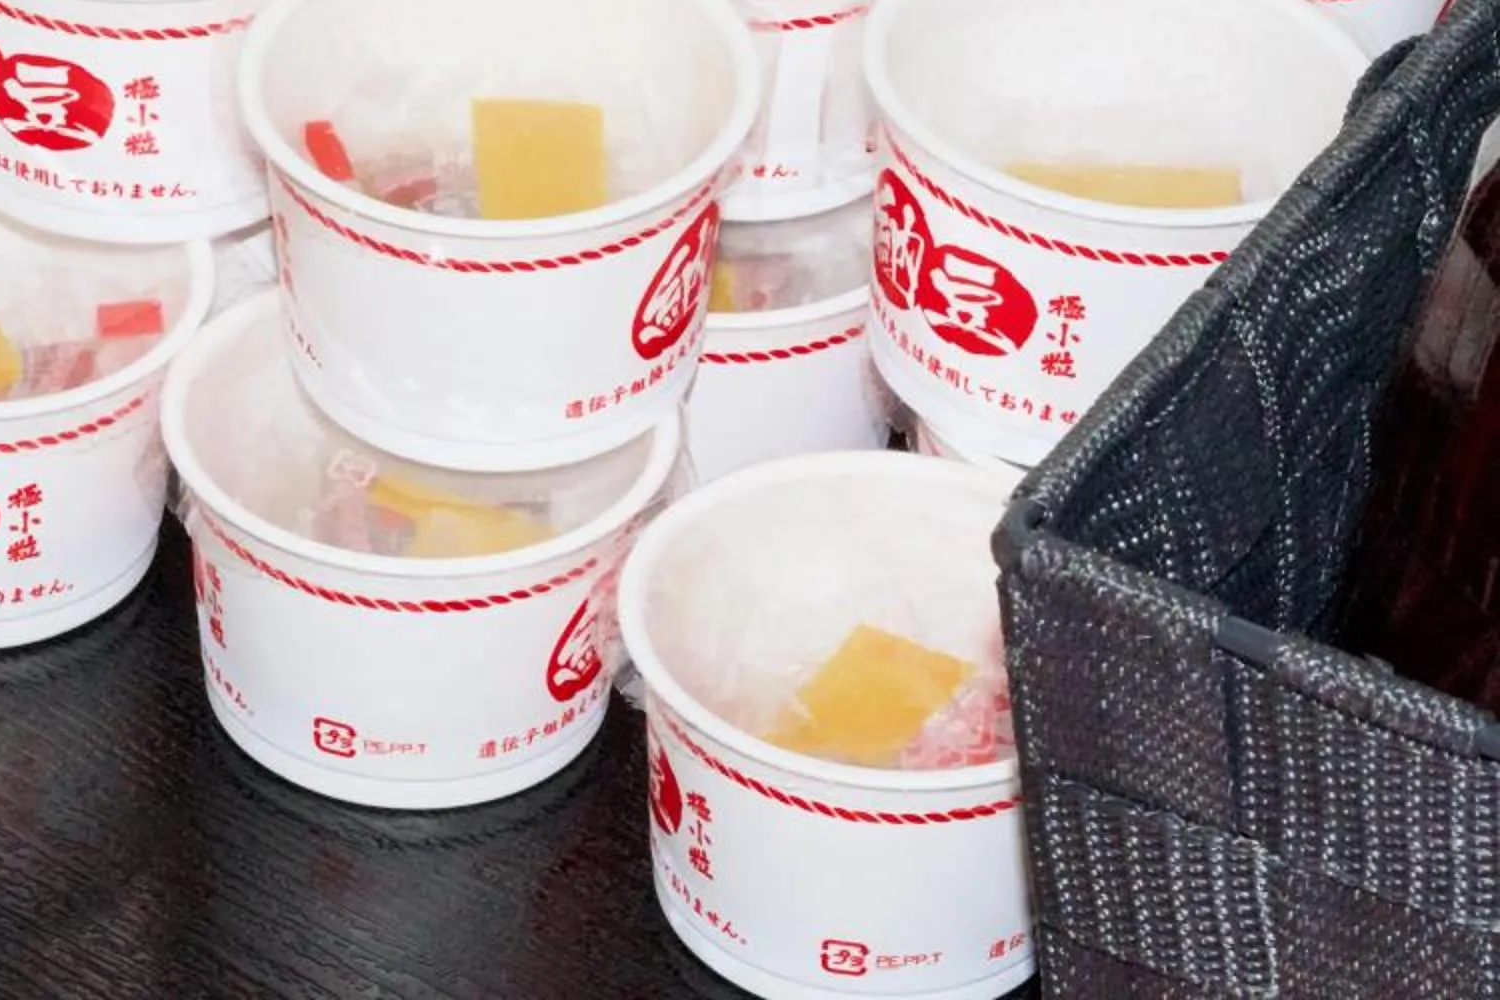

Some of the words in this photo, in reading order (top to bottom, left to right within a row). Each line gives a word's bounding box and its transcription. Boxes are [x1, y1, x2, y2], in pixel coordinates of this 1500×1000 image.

[124, 76, 161, 156] 極小粒
[1041, 295, 1087, 379] 極小粒
[8, 482, 42, 563] 極小粒
